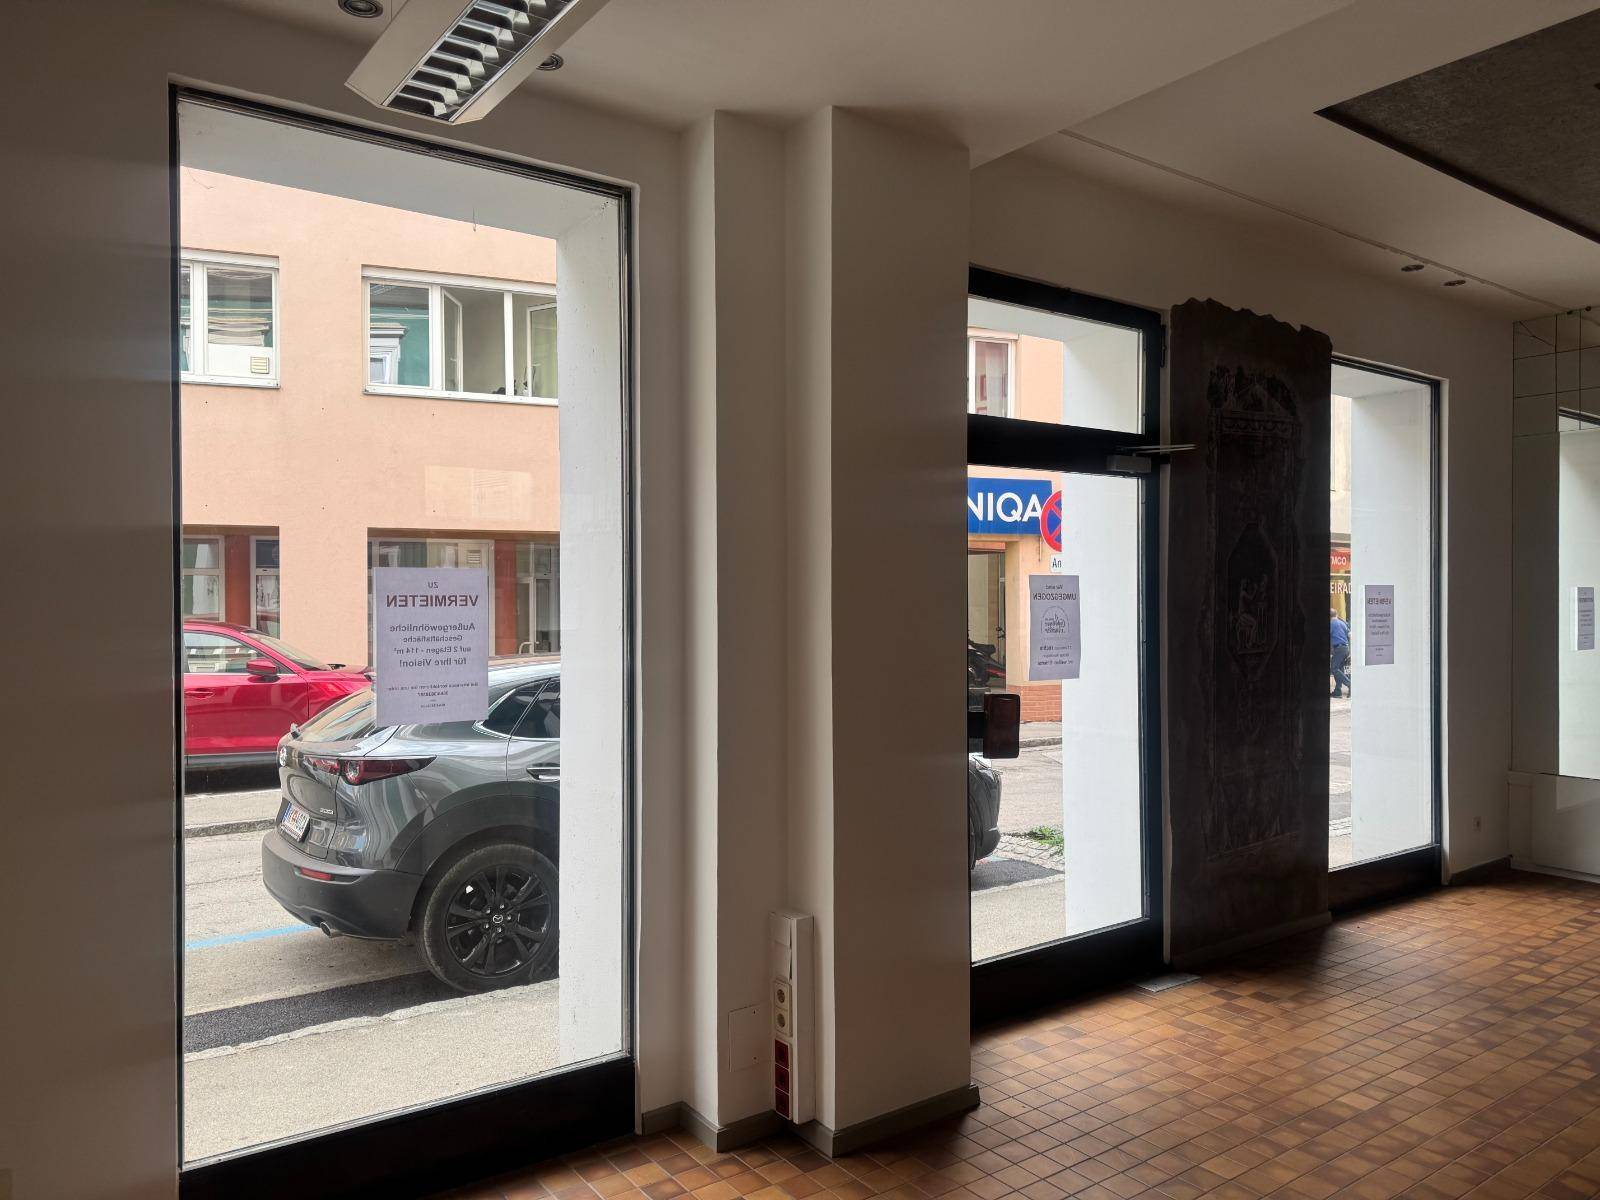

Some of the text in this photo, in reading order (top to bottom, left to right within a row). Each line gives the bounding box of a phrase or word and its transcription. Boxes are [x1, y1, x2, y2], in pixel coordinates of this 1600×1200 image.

[967, 491, 1042, 523] NIQA
[1052, 558, 1062, 568] An
[1330, 556, 1347, 566] MCO
